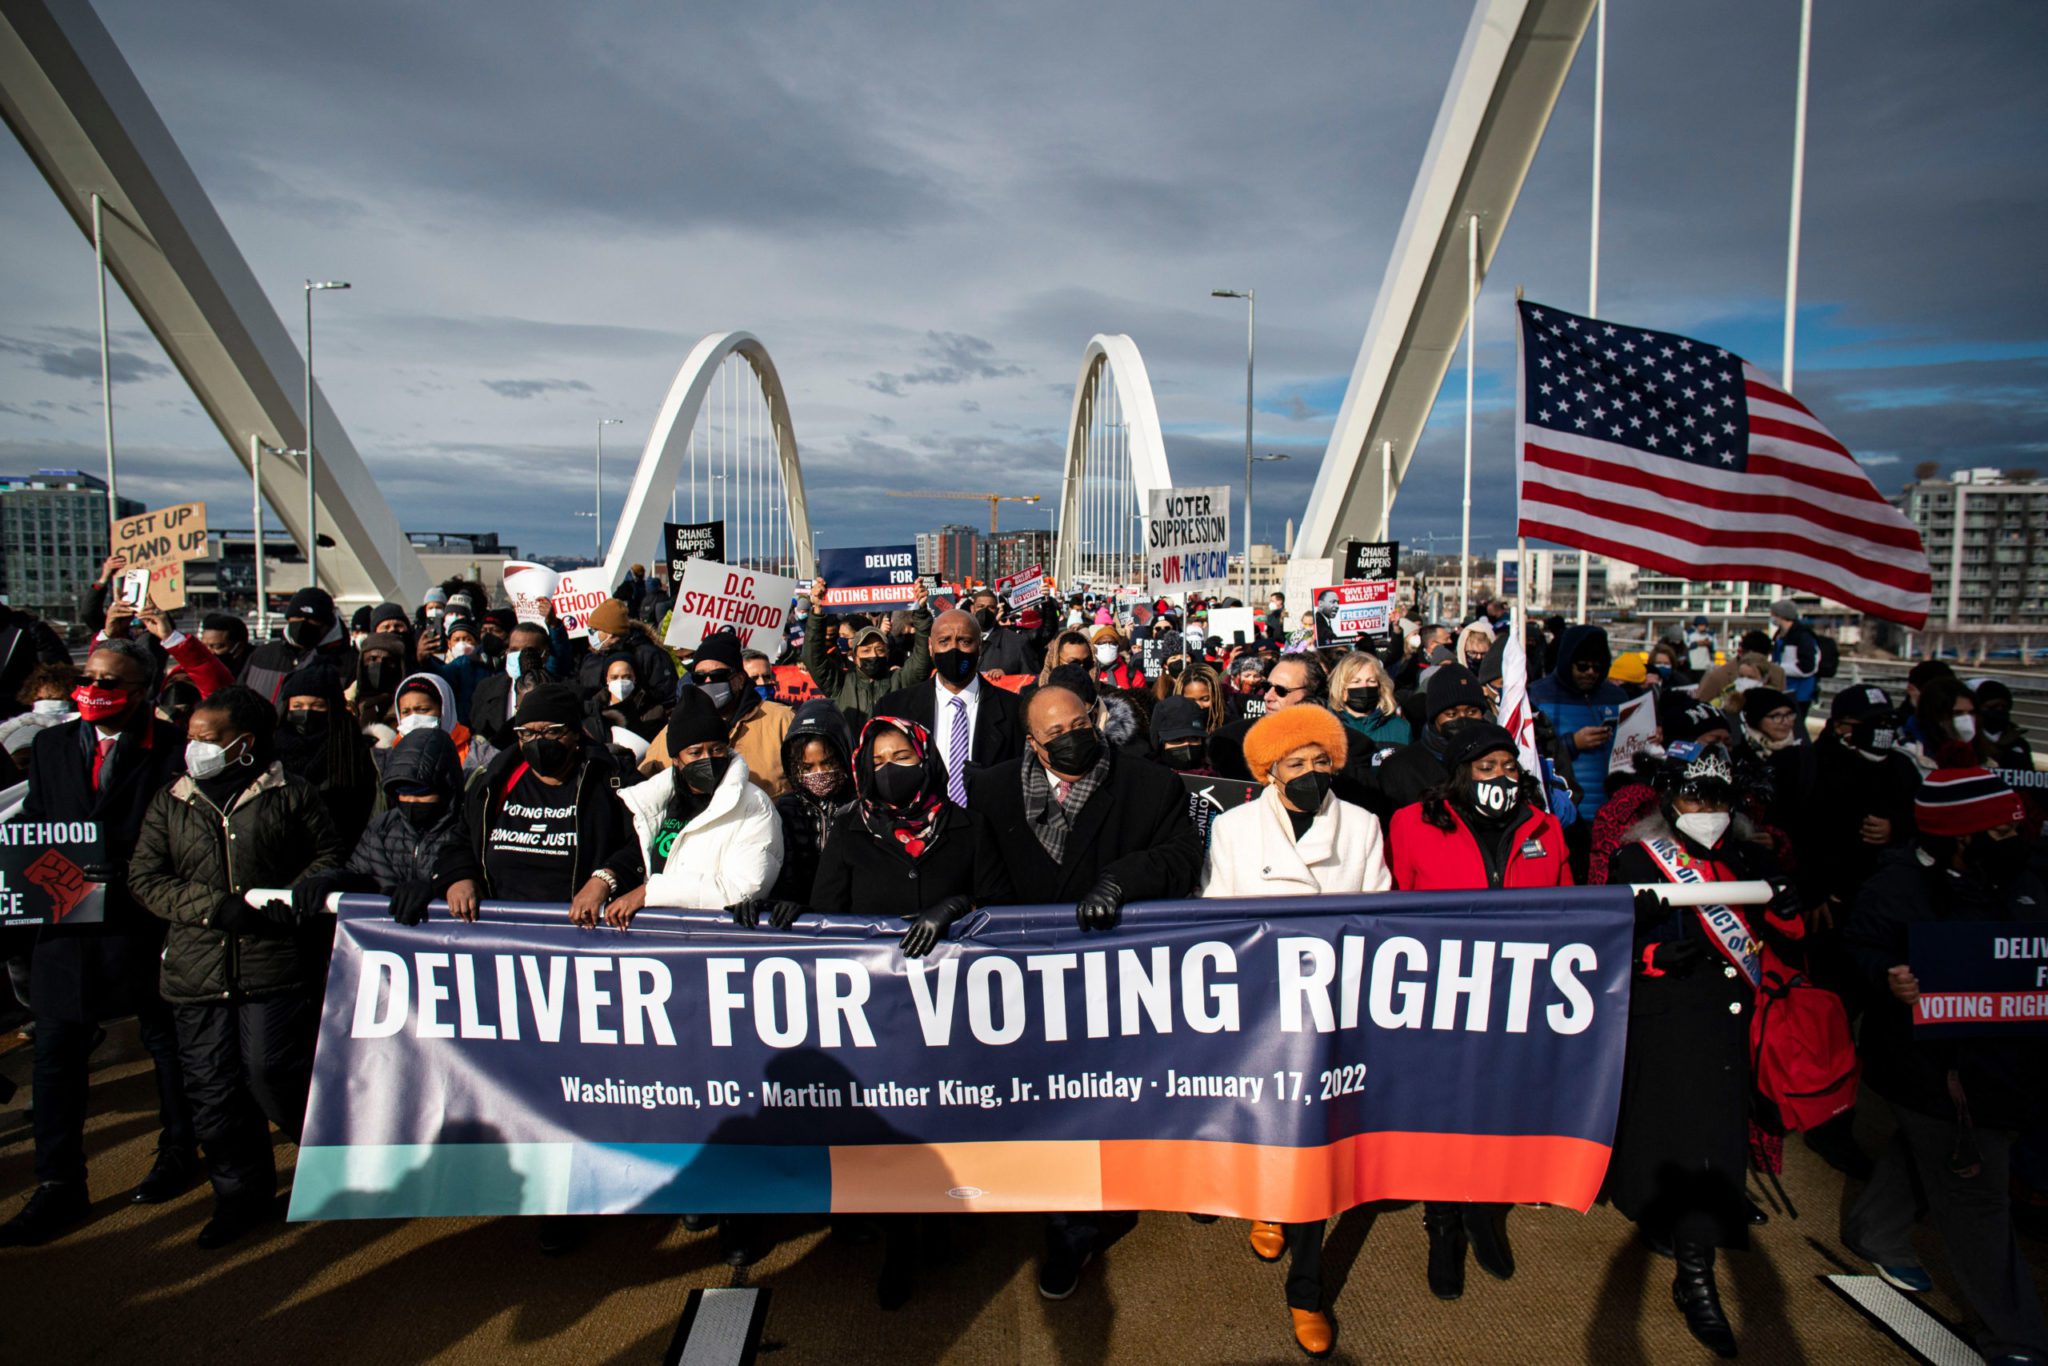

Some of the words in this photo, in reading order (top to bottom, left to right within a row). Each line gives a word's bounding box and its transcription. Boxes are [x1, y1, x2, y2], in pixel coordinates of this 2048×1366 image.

[1166, 495, 1210, 518] VOTER
[121, 515, 156, 539] GET
[164, 508, 191, 529] UP
[677, 527, 712, 540] CHANGE
[1150, 516, 1225, 548] SUPPRESSION
[116, 536, 171, 564] STAND
[178, 530, 206, 550] UP
[676, 538, 715, 550] HAPPENS
[1361, 546, 1390, 557] CHANGE
[672, 559, 688, 570] GO
[865, 553, 912, 568] DELIVER
[1357, 558, 1391, 568] HAPPENS
[151, 562, 179, 581] OTE
[890, 570, 913, 584] FOR
[1151, 563, 1160, 578] is
[724, 572, 755, 600] D.C.
[928, 587, 952, 596] TEHOOD
[1363, 585, 1373, 594] US
[1373, 584, 1386, 593] THE
[826, 589, 868, 603] VOTING
[872, 586, 914, 601] RIGHTS
[551, 591, 607, 615] TEHOOD
[682, 591, 782, 629] STATEHOOD
[1341, 607, 1380, 620] FREEDOM
[1341, 621, 1357, 631] TO
[1358, 618, 1380, 629] VOTE
[1144, 640, 1154, 649] DC
[1144, 650, 1151, 658] IS
[1144, 660, 1160, 668] RAC
[1145, 669, 1162, 678] JUST
[1246, 700, 1266, 713] CHA
[1993, 769, 2048, 788] TEHOO
[1478, 782, 1518, 812] VOTE
[503, 801, 542, 818] VOTING
[544, 805, 577, 819] RIGHT
[0, 822, 97, 846] ATEHOOD
[542, 833, 577, 846] JUSTI
[1652, 840, 1677, 864] MS.
[1994, 938, 2048, 959] DELIV
[351, 950, 678, 1046] DELIVER
[706, 957, 877, 1048] FOR
[906, 941, 1241, 1047] VOTING
[1277, 935, 1598, 1035] RIGHTS
[1920, 996, 1993, 1019] VOTING
[2000, 995, 2048, 1017] RIGH
[560, 1076, 701, 1110] Washington,
[707, 1080, 740, 1106] DC
[762, 1081, 842, 1107] Martin
[851, 1081, 930, 1107] Luther
[938, 1080, 1002, 1108] King,
[1010, 1077, 1040, 1103] Jr.
[1048, 1071, 1143, 1102] Holiday
[1166, 1070, 1264, 1104] January
[1273, 1071, 1312, 1105] 17,
[1320, 1064, 1366, 1101] 2022
